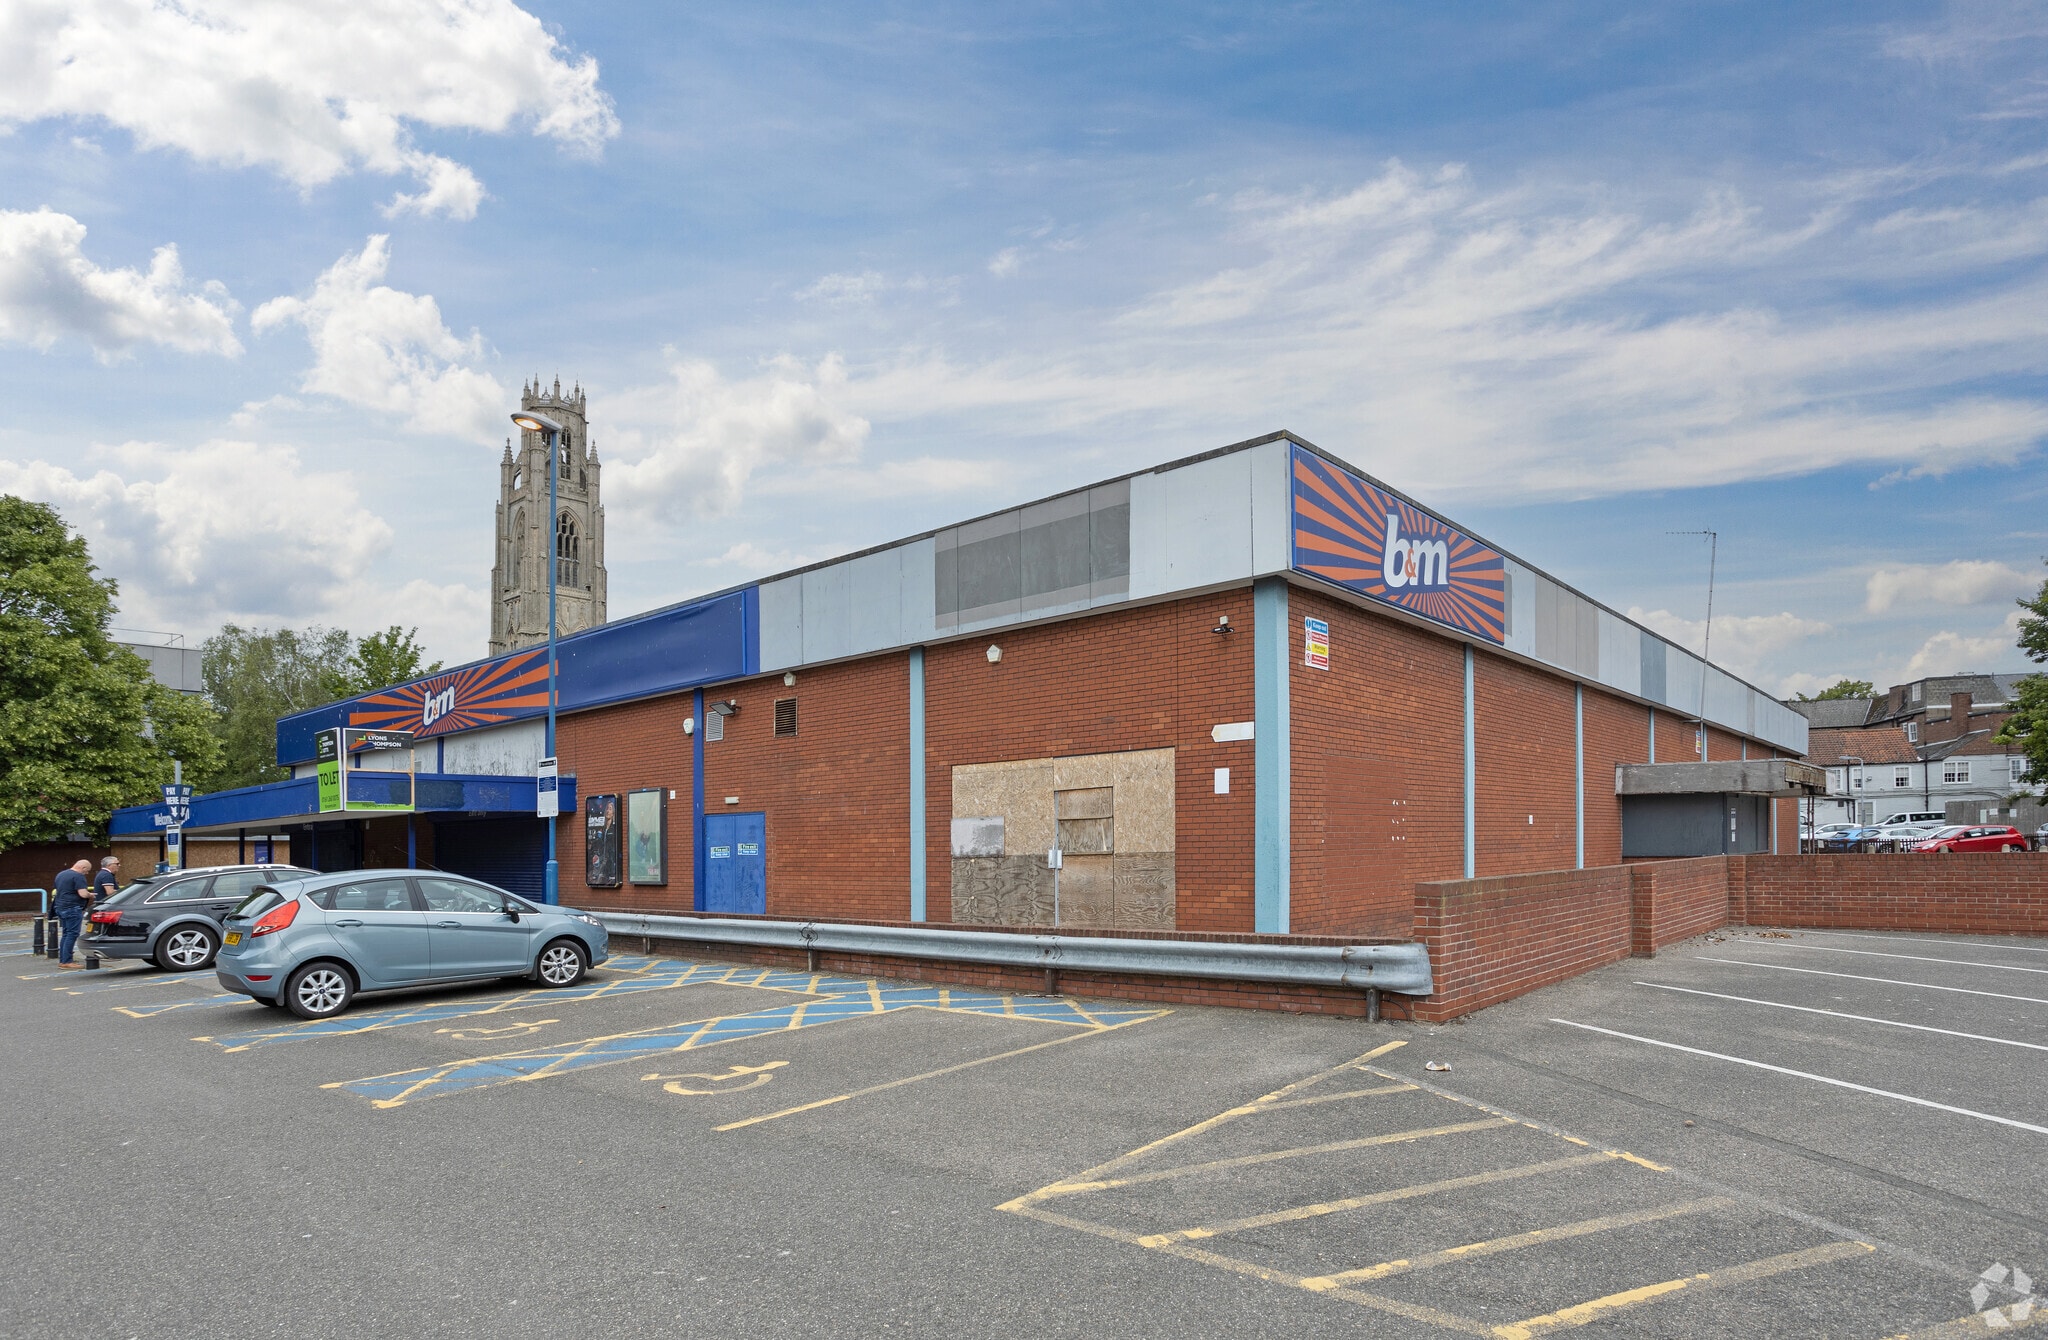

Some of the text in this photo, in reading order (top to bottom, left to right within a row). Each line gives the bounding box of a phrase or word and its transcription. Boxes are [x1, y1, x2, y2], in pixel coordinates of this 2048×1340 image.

[1384, 514, 1449, 588] b&m
[423, 685, 455, 726] b&m
[319, 771, 340, 786] TO LET
[165, 786, 176, 796] PAY
[182, 787, 190, 796] PAY
[166, 796, 180, 805] HERE
[180, 796, 190, 805] HERE
